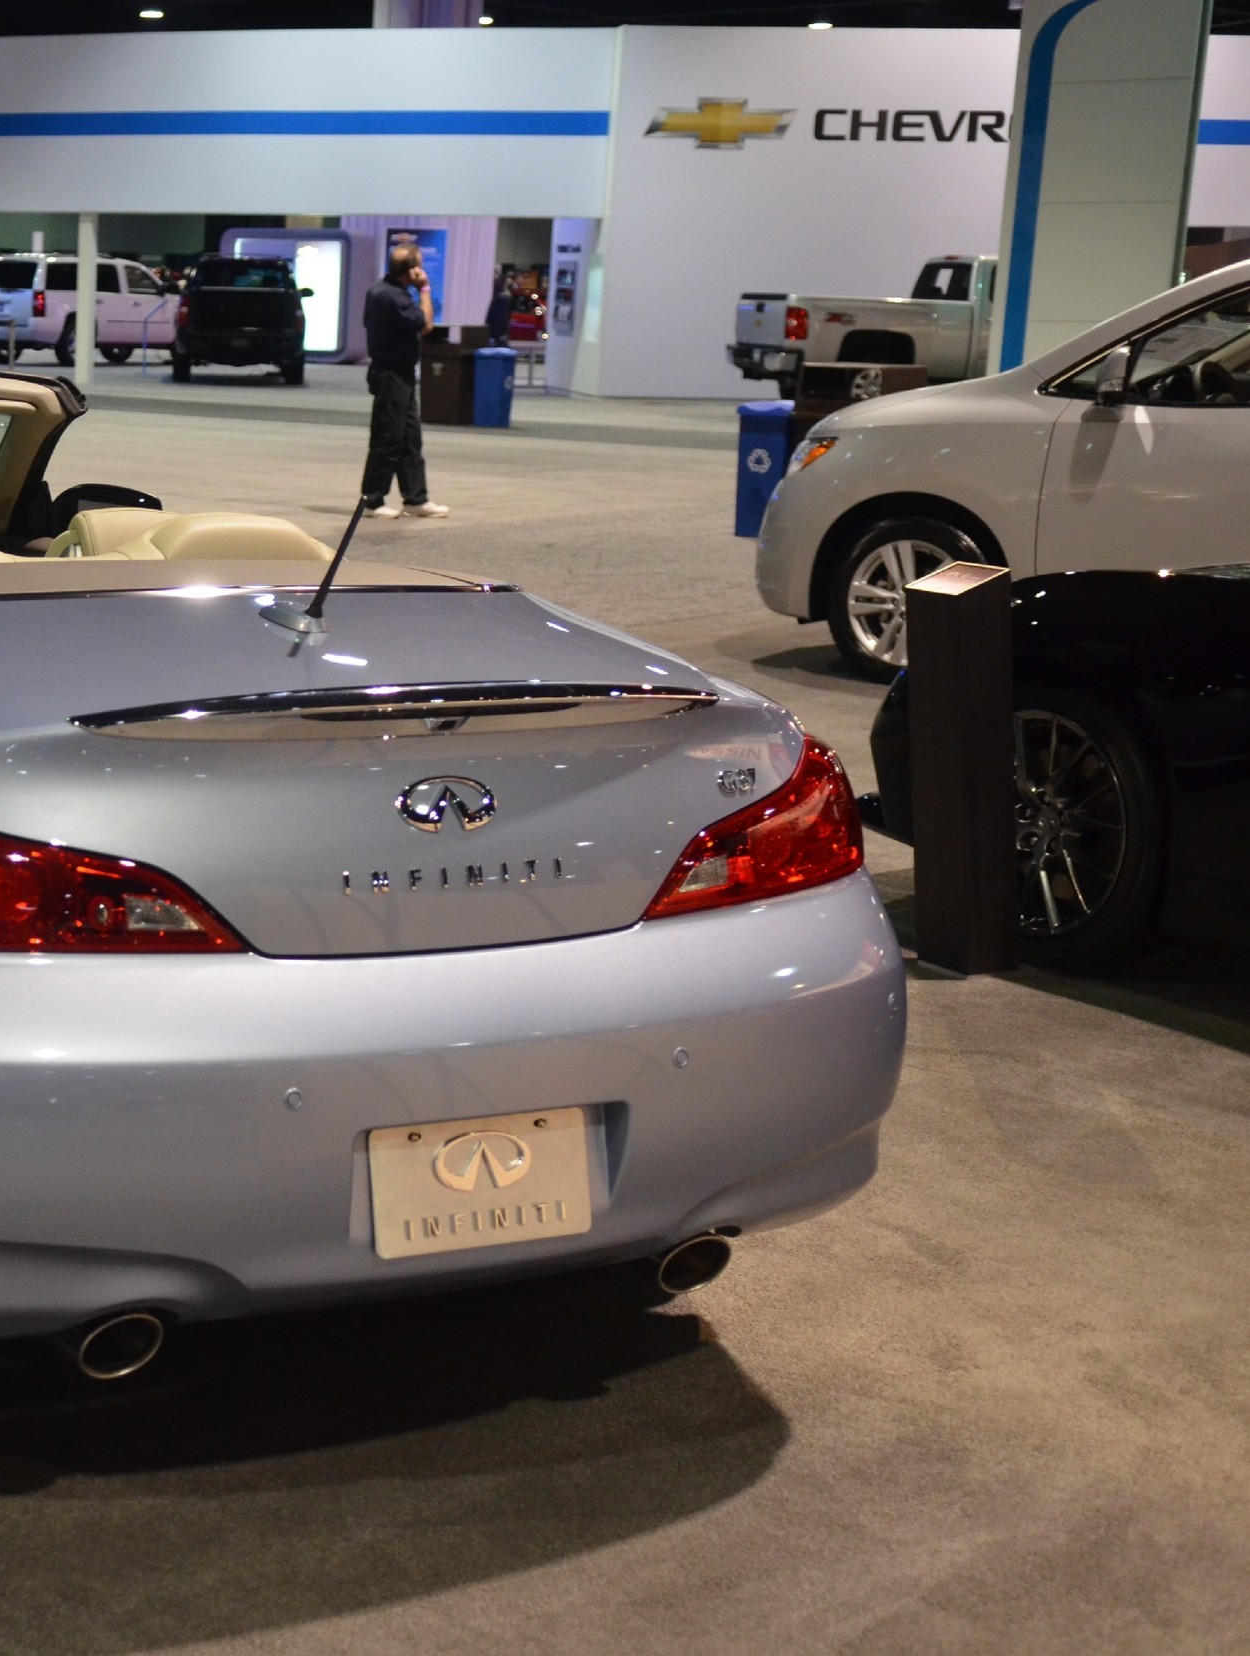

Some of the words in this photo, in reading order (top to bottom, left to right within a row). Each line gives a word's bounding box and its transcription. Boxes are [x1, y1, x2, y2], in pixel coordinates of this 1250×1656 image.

[814, 108, 1013, 143] CHEVR
[717, 767, 756, 794] G37
[342, 856, 562, 896] INFINITI
[403, 1200, 567, 1241] INFINITI
